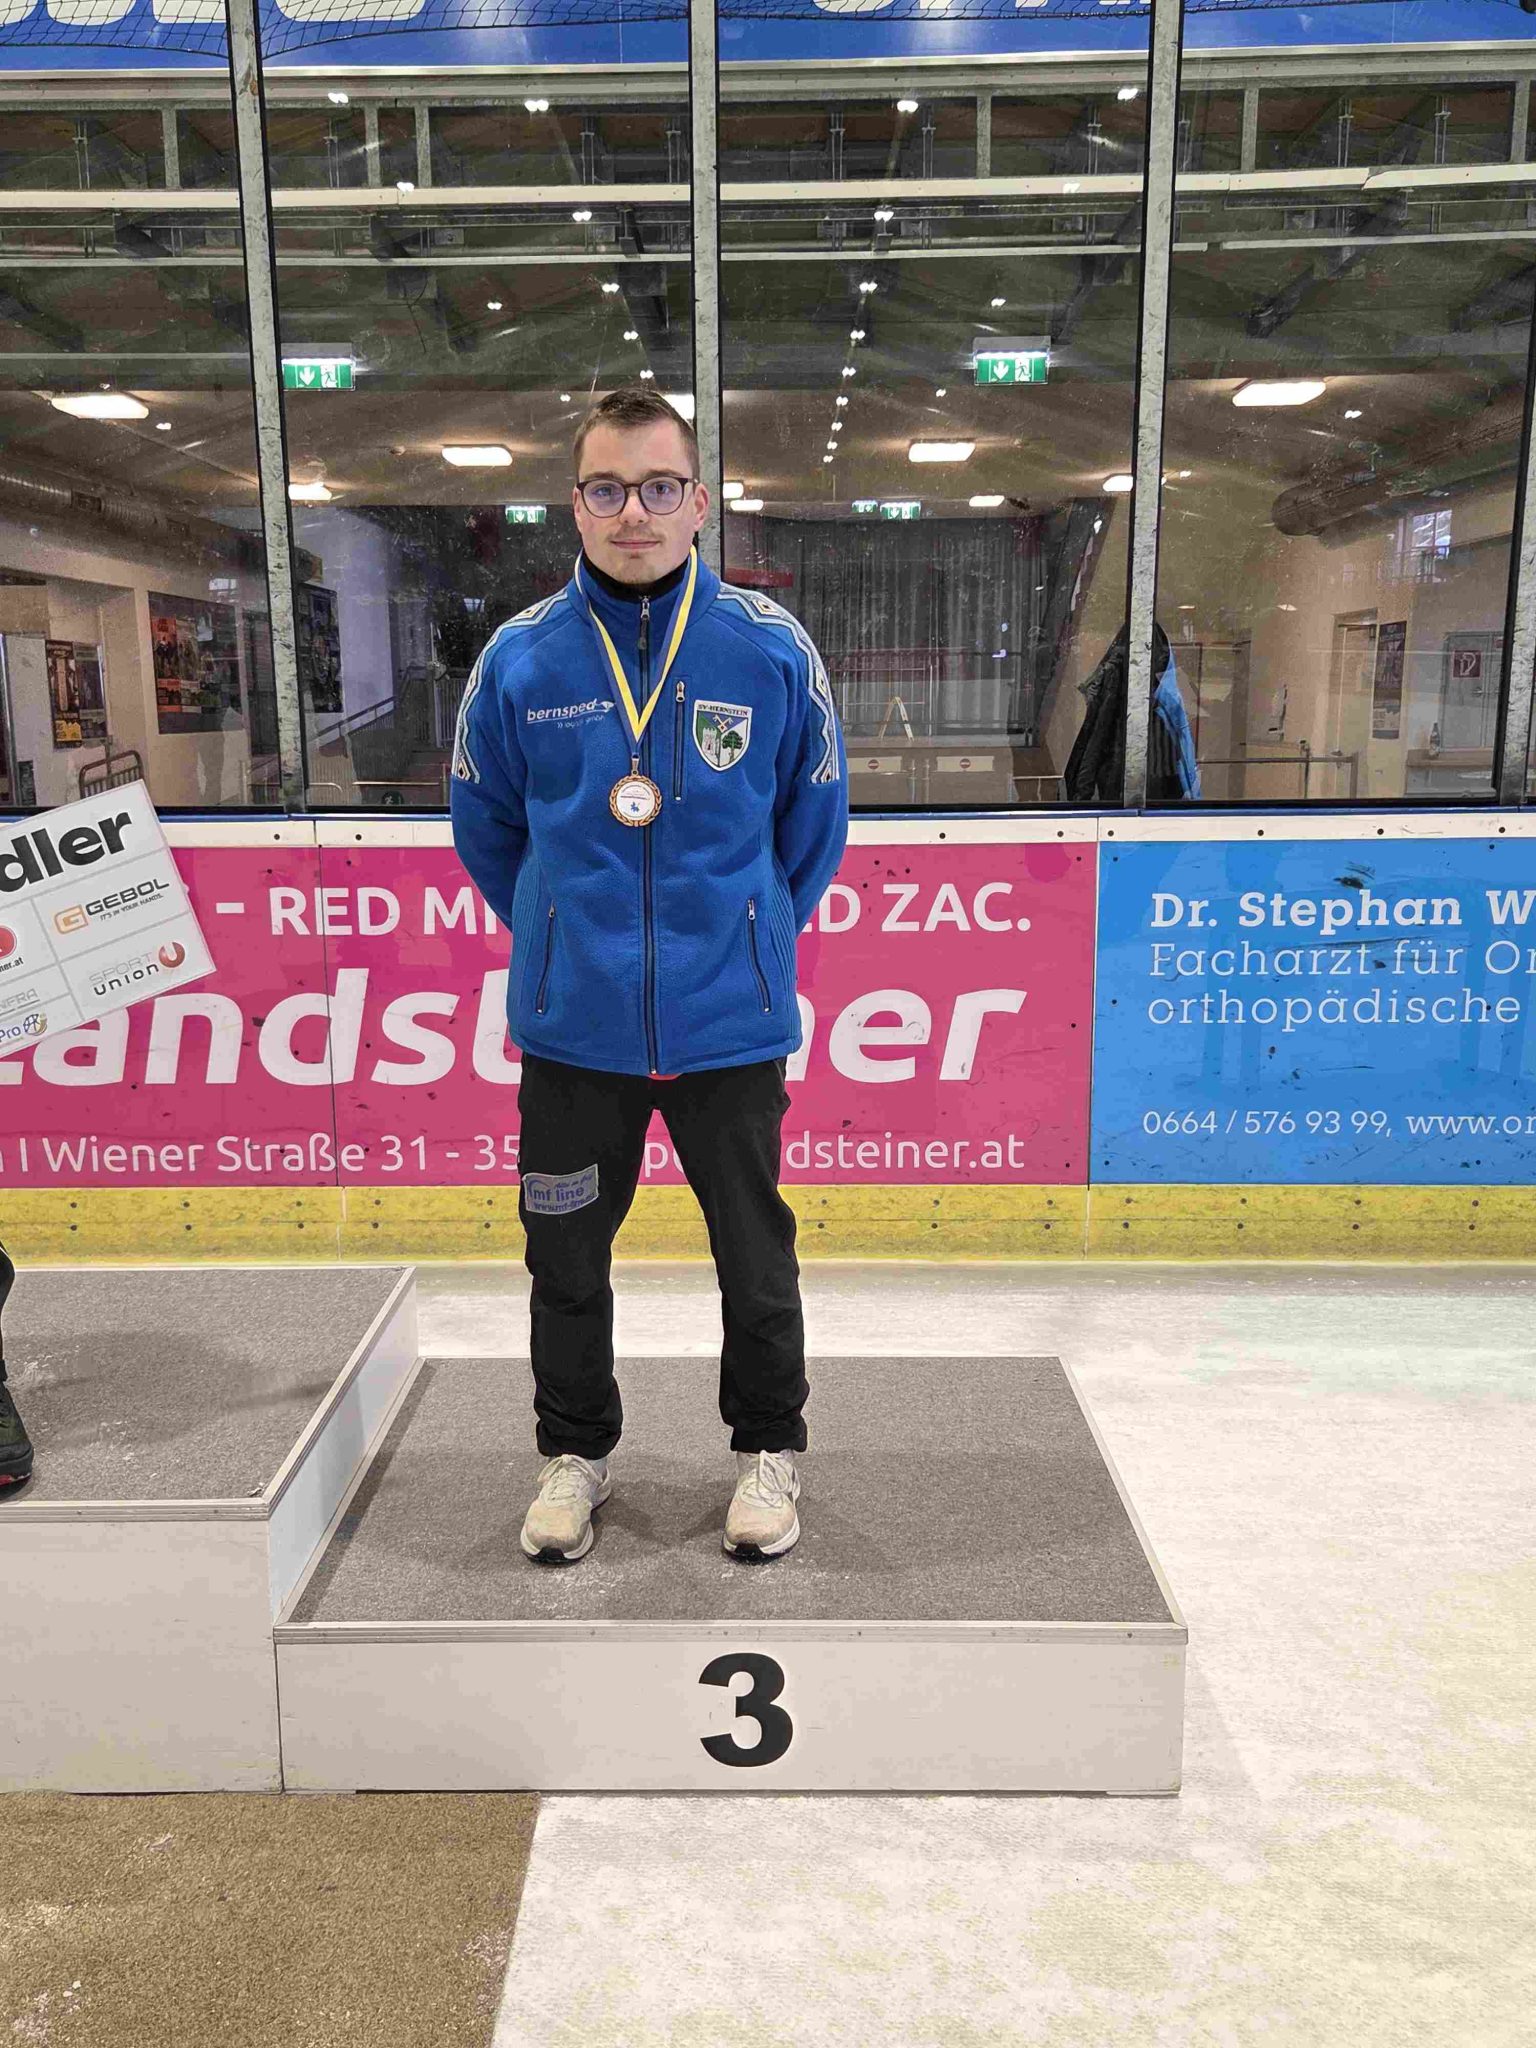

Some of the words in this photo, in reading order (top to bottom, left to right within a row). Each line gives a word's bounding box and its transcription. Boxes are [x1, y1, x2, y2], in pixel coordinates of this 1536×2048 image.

[527, 698, 598, 721] bernsped
[0, 812, 132, 892] dler
[85, 878, 170, 916] GEBOL
[269, 886, 401, 935] RED
[802, 884, 861, 932] D
[881, 882, 1031, 932] ZAC.
[1151, 892, 1218, 927] Dr.
[1238, 889, 1462, 935] Stephan
[89, 952, 152, 983] SPORT
[1150, 940, 1370, 976] Facharzt
[1392, 940, 1464, 974] für
[1148, 988, 1520, 1033] orthopädische
[1143, 1111, 1218, 1135] 0664
[1244, 1111, 1296, 1135] 576
[1305, 1111, 1341, 1134] 93
[1351, 1111, 1392, 1138] 99,
[42, 1135, 204, 1172] Wiener
[217, 1132, 365, 1172] Straße
[380, 1135, 426, 1172] 31
[473, 1134, 520, 1171] 35
[644, 1142, 684, 1178] p
[785, 1130, 1025, 1169] dsteiner.at
[533, 1189, 553, 1201] mf
[556, 1186, 584, 1202] line
[698, 1652, 794, 1768] 3
